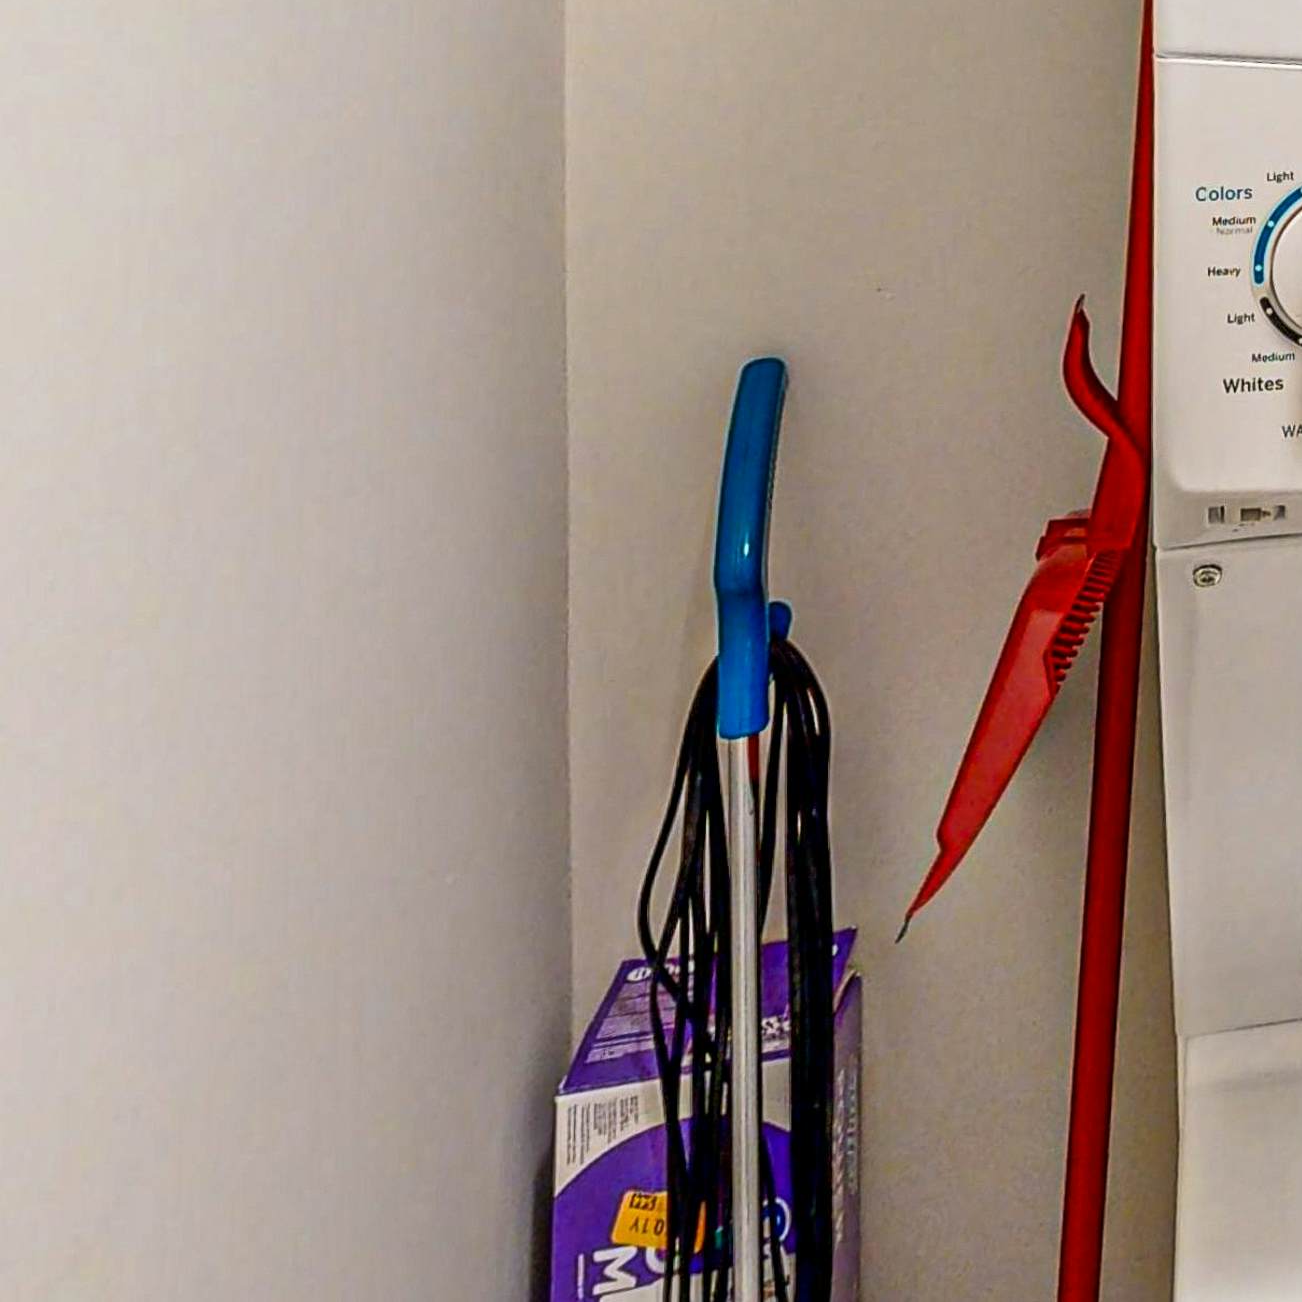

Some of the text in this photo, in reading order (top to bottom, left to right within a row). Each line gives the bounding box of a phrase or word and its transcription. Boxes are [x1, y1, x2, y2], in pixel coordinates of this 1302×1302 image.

[1266, 171, 1295, 184] Light
[1195, 186, 1254, 202] Colors
[1212, 216, 1257, 227] Medium
[1207, 266, 1241, 278] Heavy
[1227, 313, 1256, 324] Light
[1251, 352, 1296, 363] Medium
[1222, 377, 1285, 394] Whites
